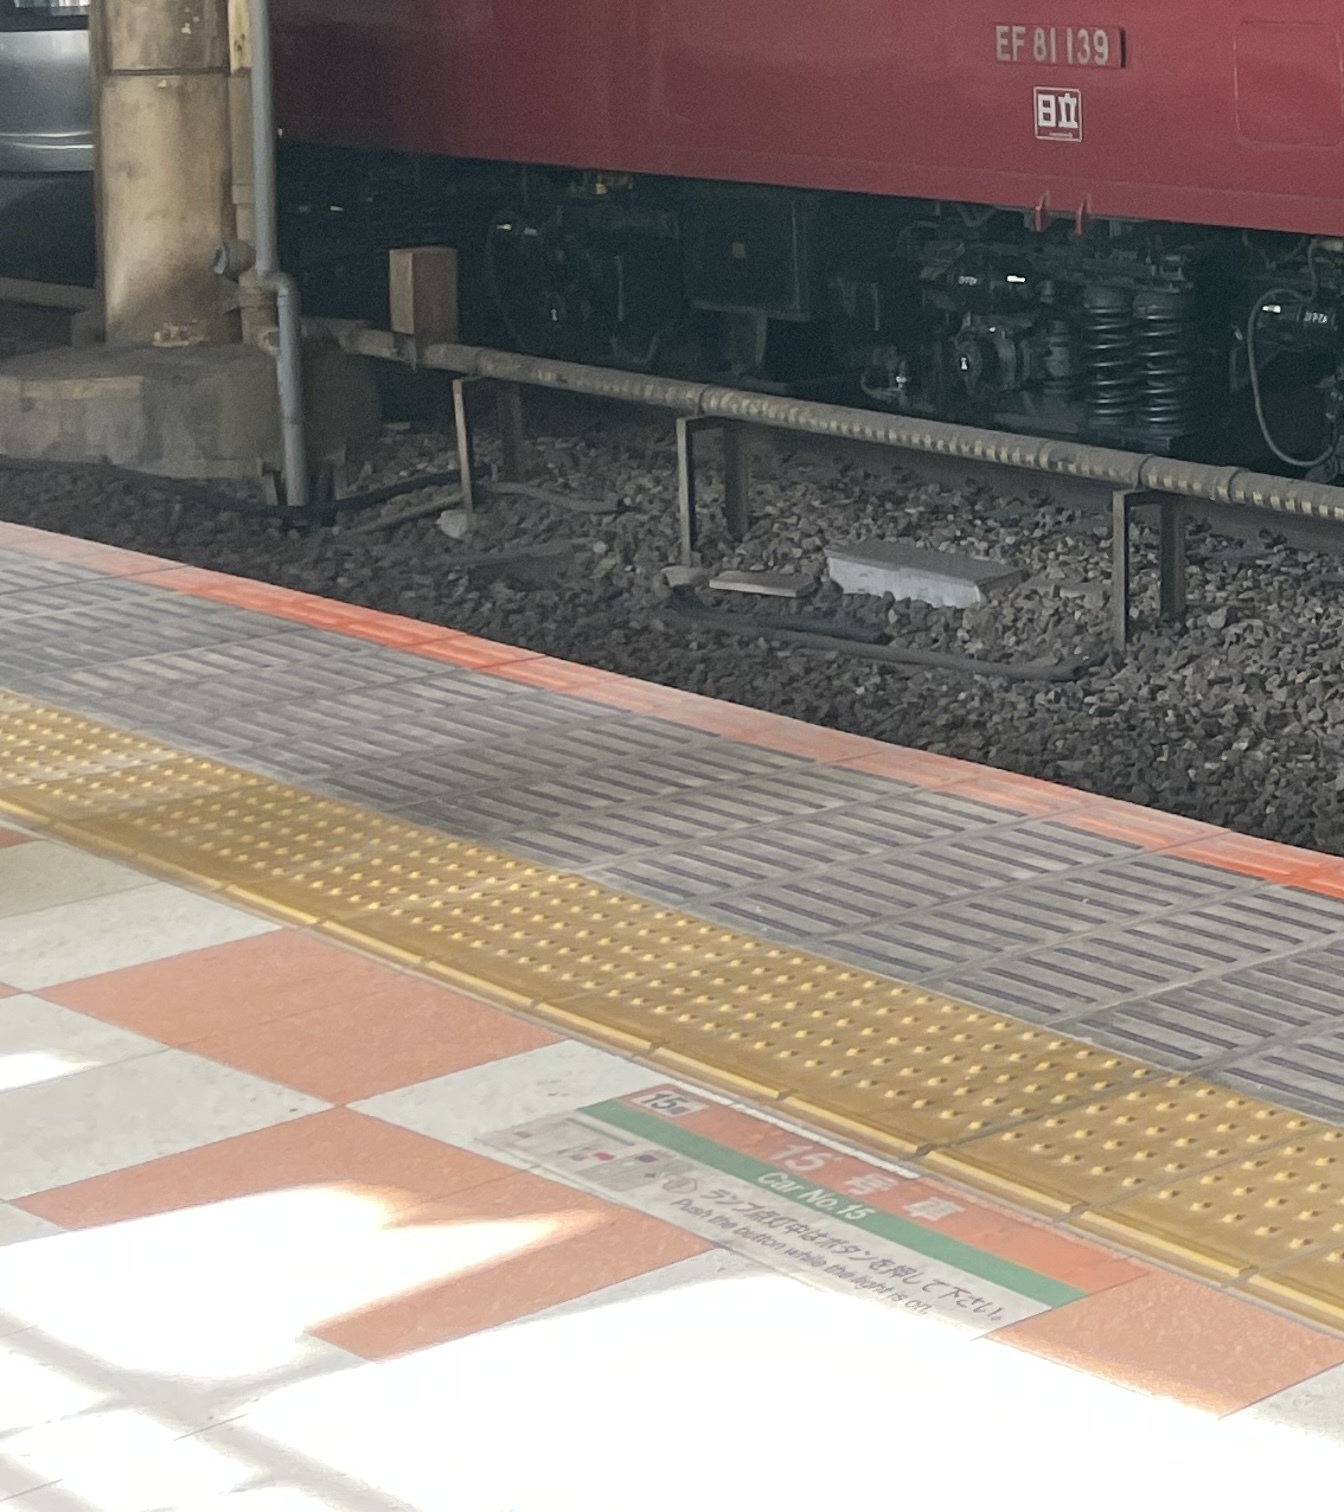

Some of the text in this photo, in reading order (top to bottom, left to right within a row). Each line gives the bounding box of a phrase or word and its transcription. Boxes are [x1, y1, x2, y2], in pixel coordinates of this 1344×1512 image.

[1037, 92, 1079, 129] 日立
[757, 1171, 801, 1193] Car
[670, 1197, 714, 1219] Push
[707, 1214, 738, 1230] the
[732, 1225, 787, 1251] button
[784, 1246, 828, 1268] while
[823, 1263, 856, 1280] the
[849, 1274, 894, 1295] light
